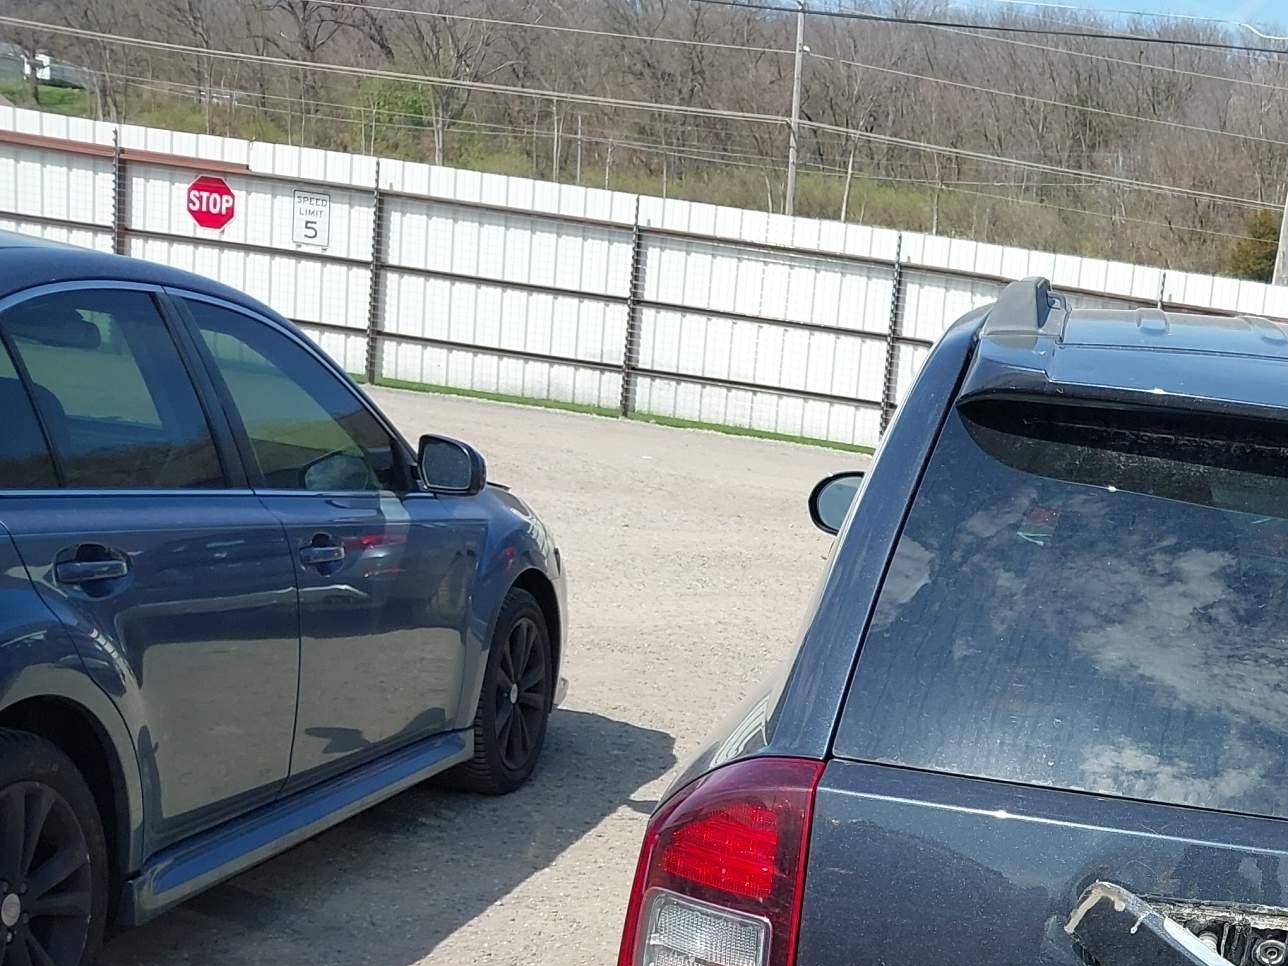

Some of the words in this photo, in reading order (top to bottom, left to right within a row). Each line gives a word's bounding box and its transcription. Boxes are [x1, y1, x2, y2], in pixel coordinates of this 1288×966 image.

[189, 190, 234, 215] STOP
[297, 195, 328, 207] SPEED
[299, 208, 323, 218] LIMIT
[304, 221, 318, 239] 5
